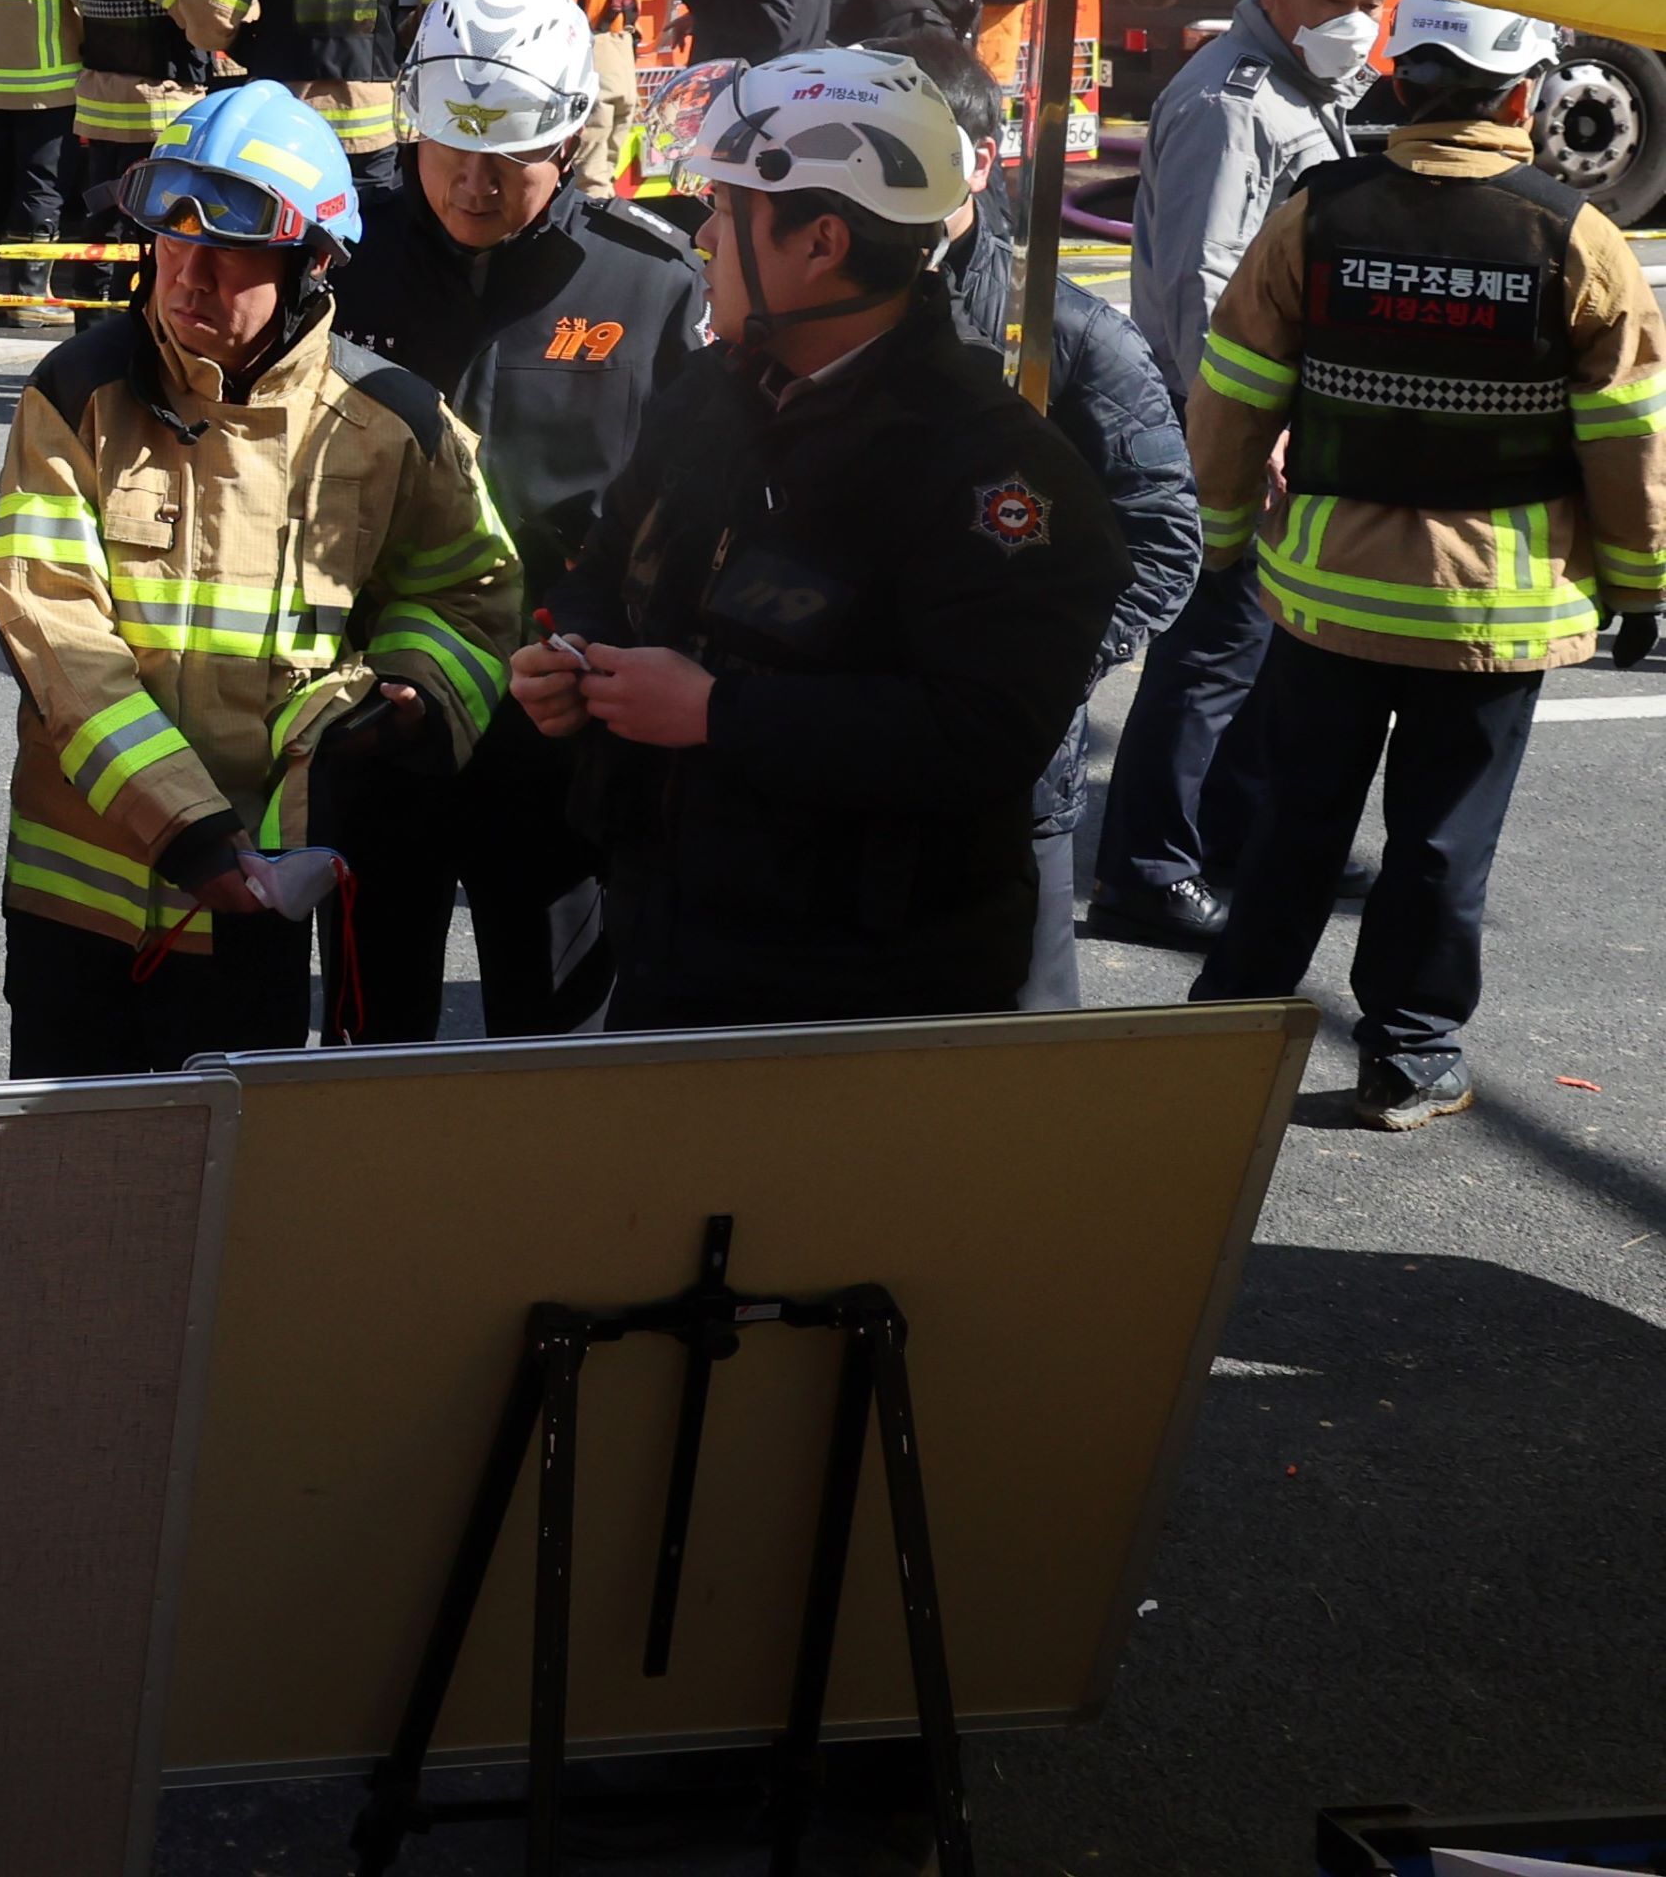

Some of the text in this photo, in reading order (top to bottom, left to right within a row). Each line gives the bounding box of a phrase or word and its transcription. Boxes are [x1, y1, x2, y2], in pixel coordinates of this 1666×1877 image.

[791, 83, 879, 106] 119 기장소방서
[1340, 257, 1533, 304] 긴급구조통제단
[556, 317, 588, 332] 소방
[1369, 292, 1498, 330] 기장소방서
[545, 322, 624, 361] 119
